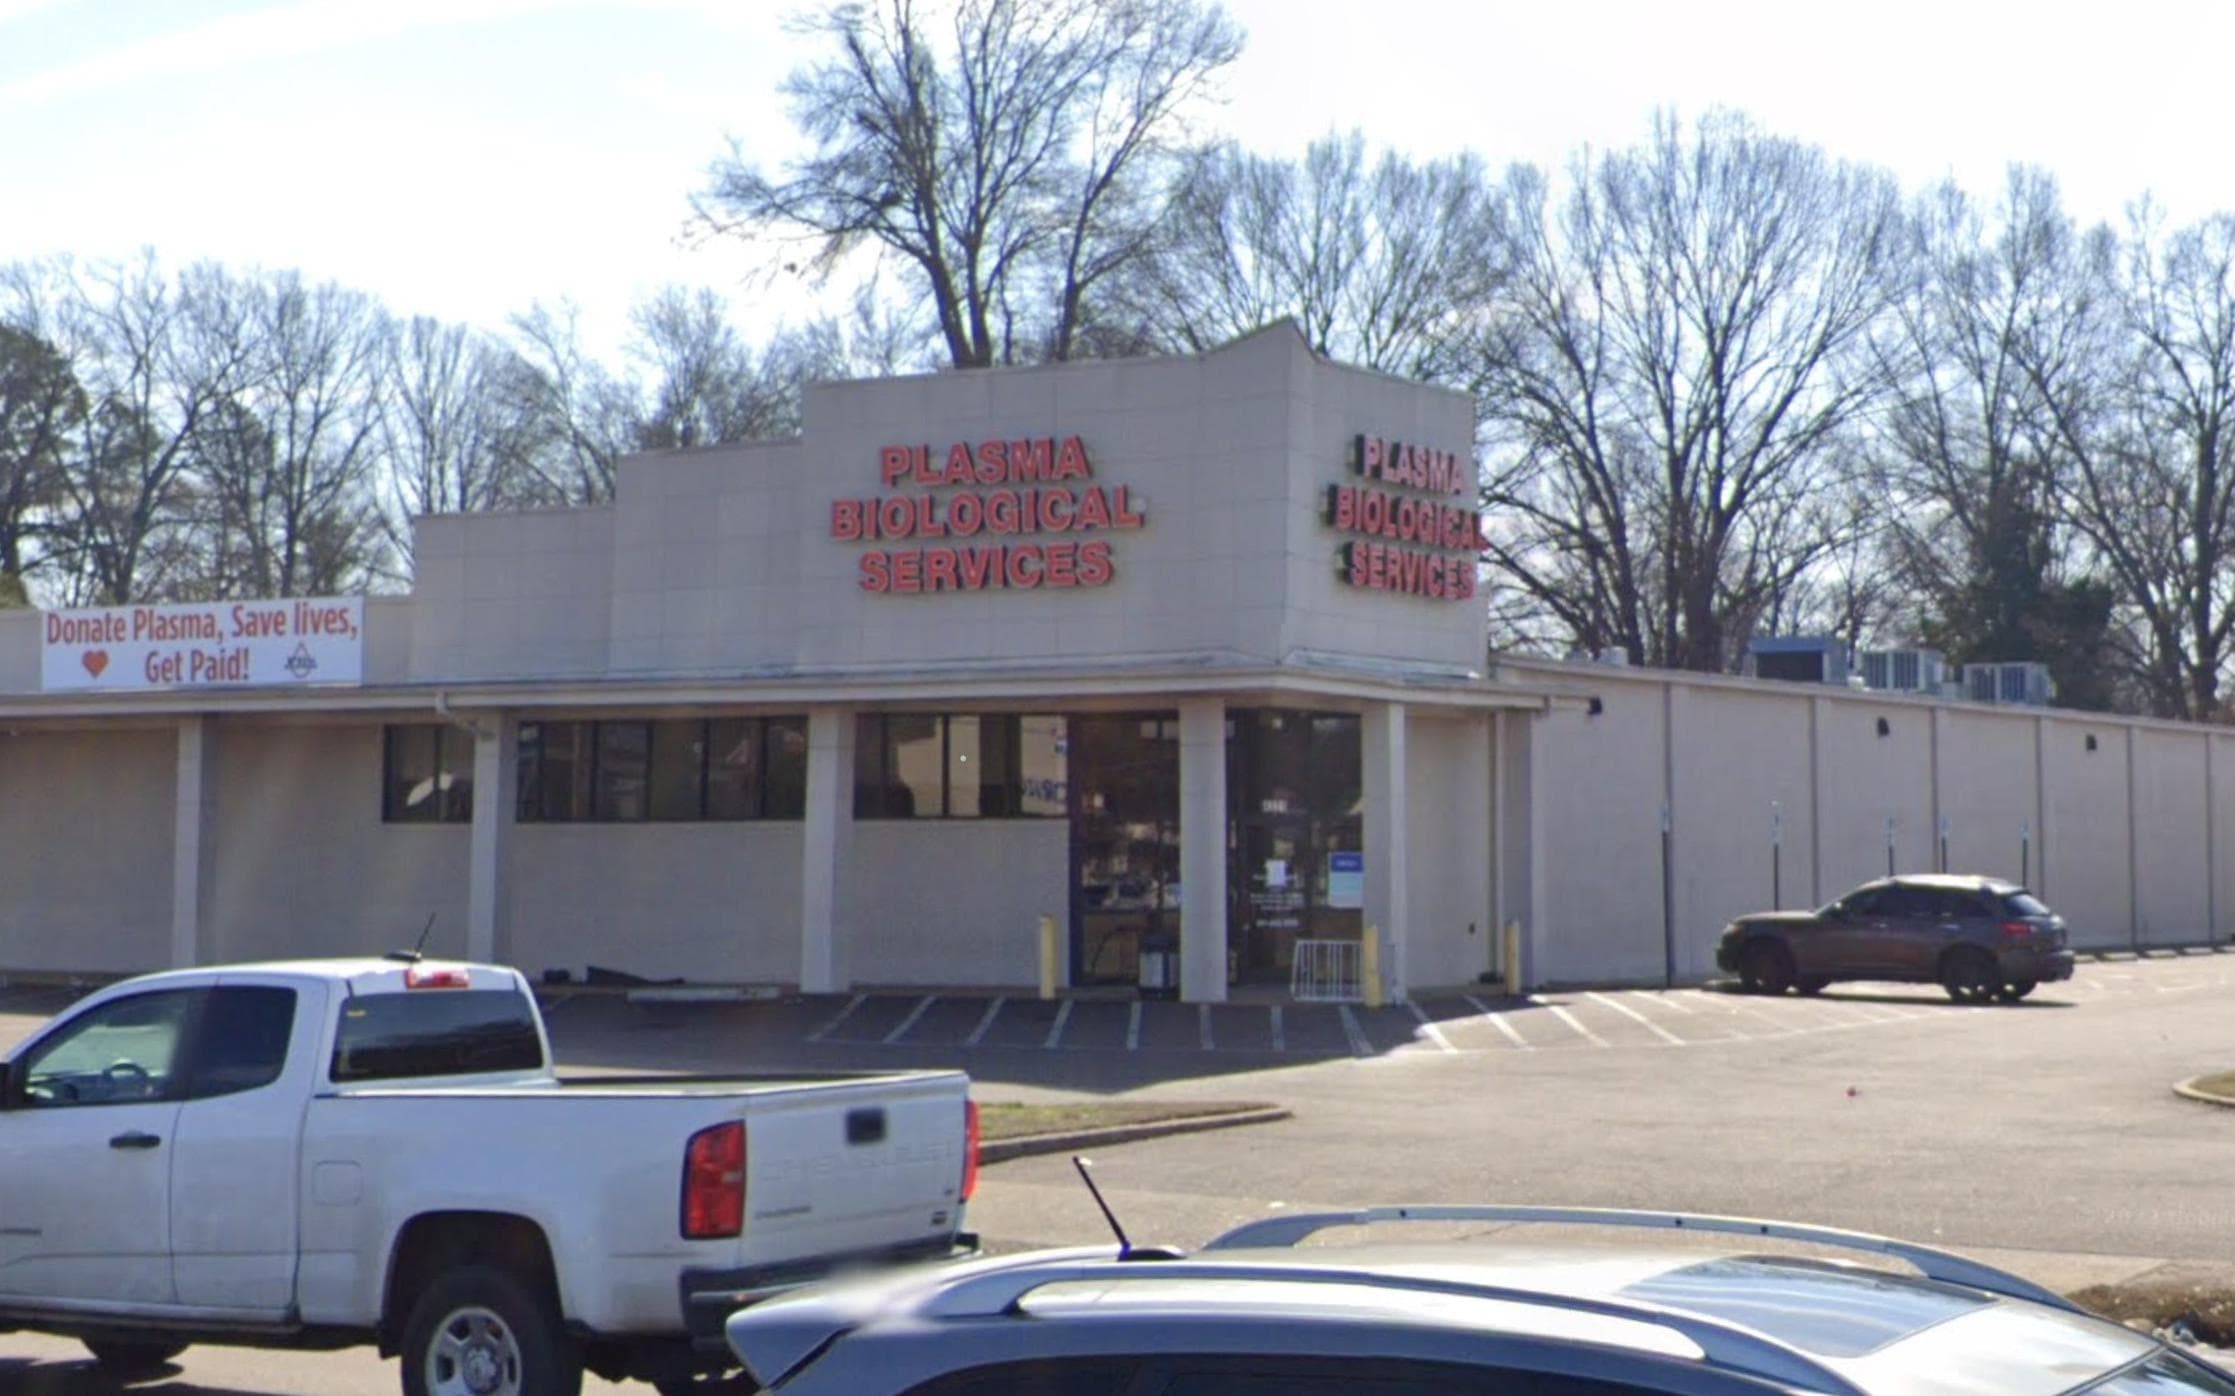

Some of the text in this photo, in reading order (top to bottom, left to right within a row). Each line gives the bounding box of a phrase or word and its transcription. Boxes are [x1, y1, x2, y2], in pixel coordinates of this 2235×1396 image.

[882, 434, 1092, 487] PLASMA
[1355, 434, 1466, 495] PLASMA
[831, 484, 1145, 541] BIOLOGICAL
[1328, 484, 1489, 552] BIOLOGICAL
[859, 541, 1114, 594] SERVICES
[1343, 541, 1476, 602] SERVICES
[47, 601, 358, 645] Donate Plasma, Save lives,
[145, 650, 183, 684] Get
[190, 647, 250, 682] Paid!
